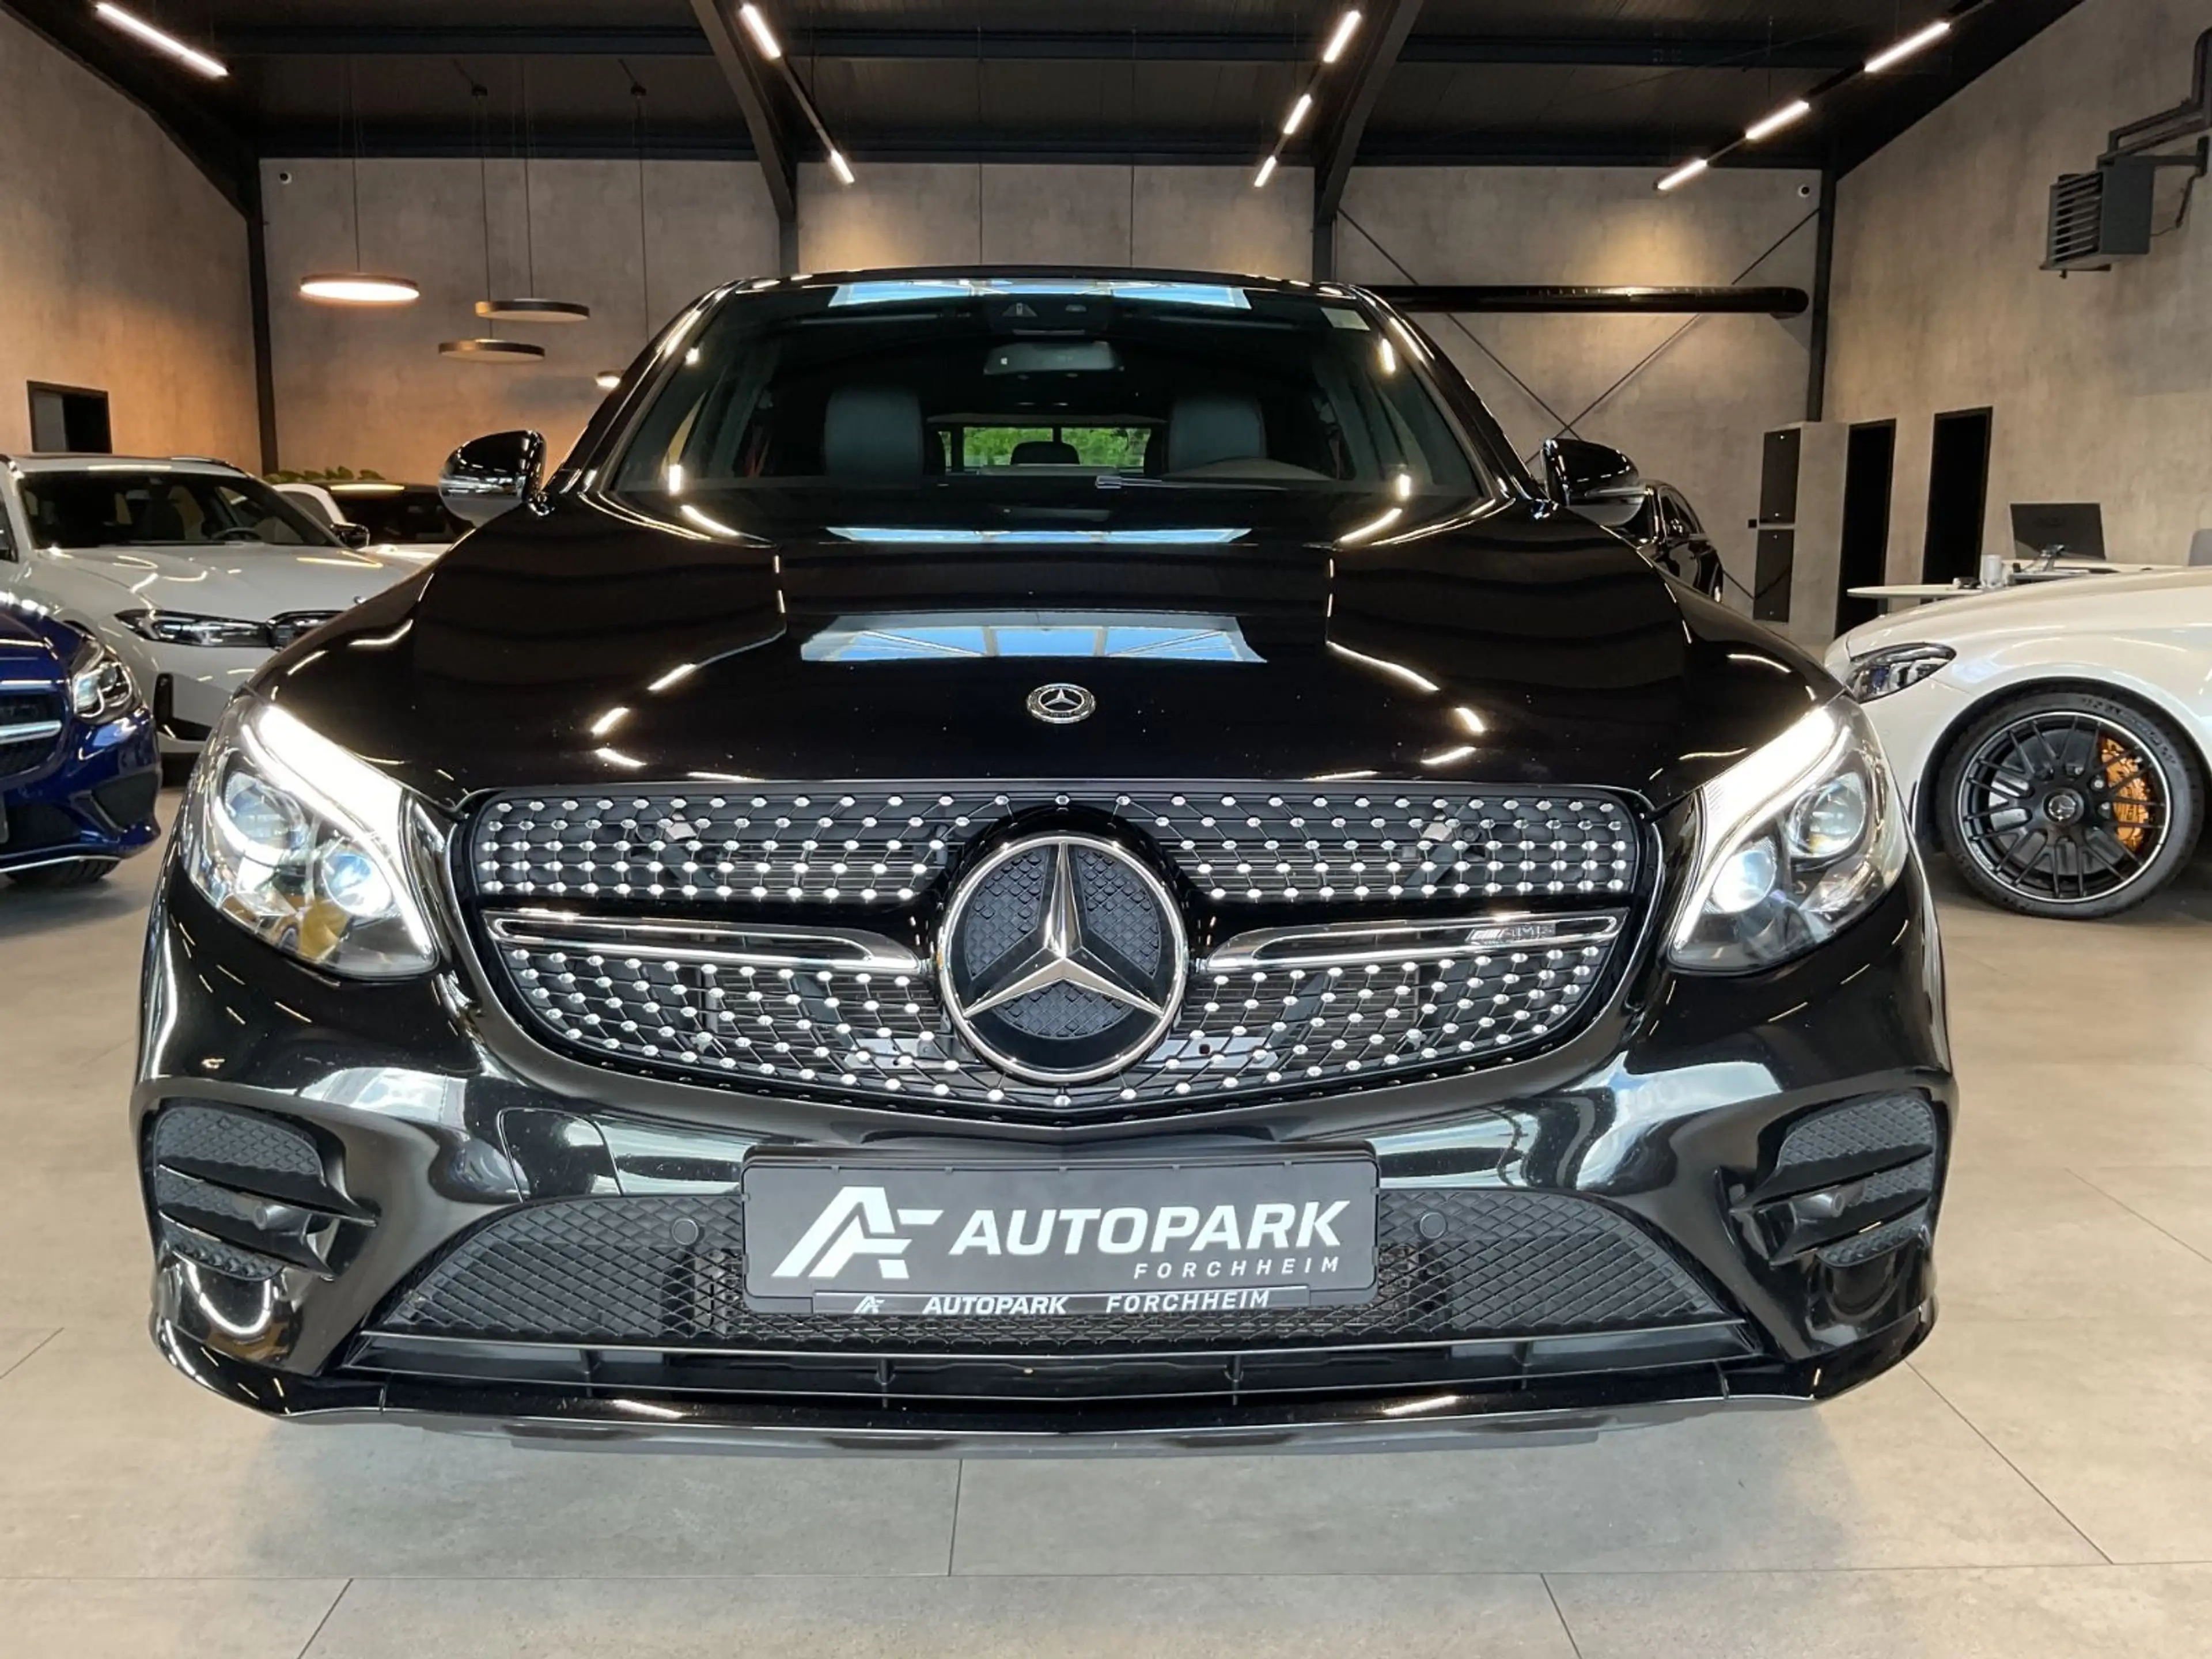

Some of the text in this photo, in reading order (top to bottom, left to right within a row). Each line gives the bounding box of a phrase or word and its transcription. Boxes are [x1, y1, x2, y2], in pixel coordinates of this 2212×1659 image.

[948, 1200, 1350, 1255] AUTOPARK
[1134, 1256, 1339, 1279] FORCHHEIM
[922, 1296, 1070, 1315] AUTOPARK
[1105, 1289, 1270, 1313] FORCHHEIM
